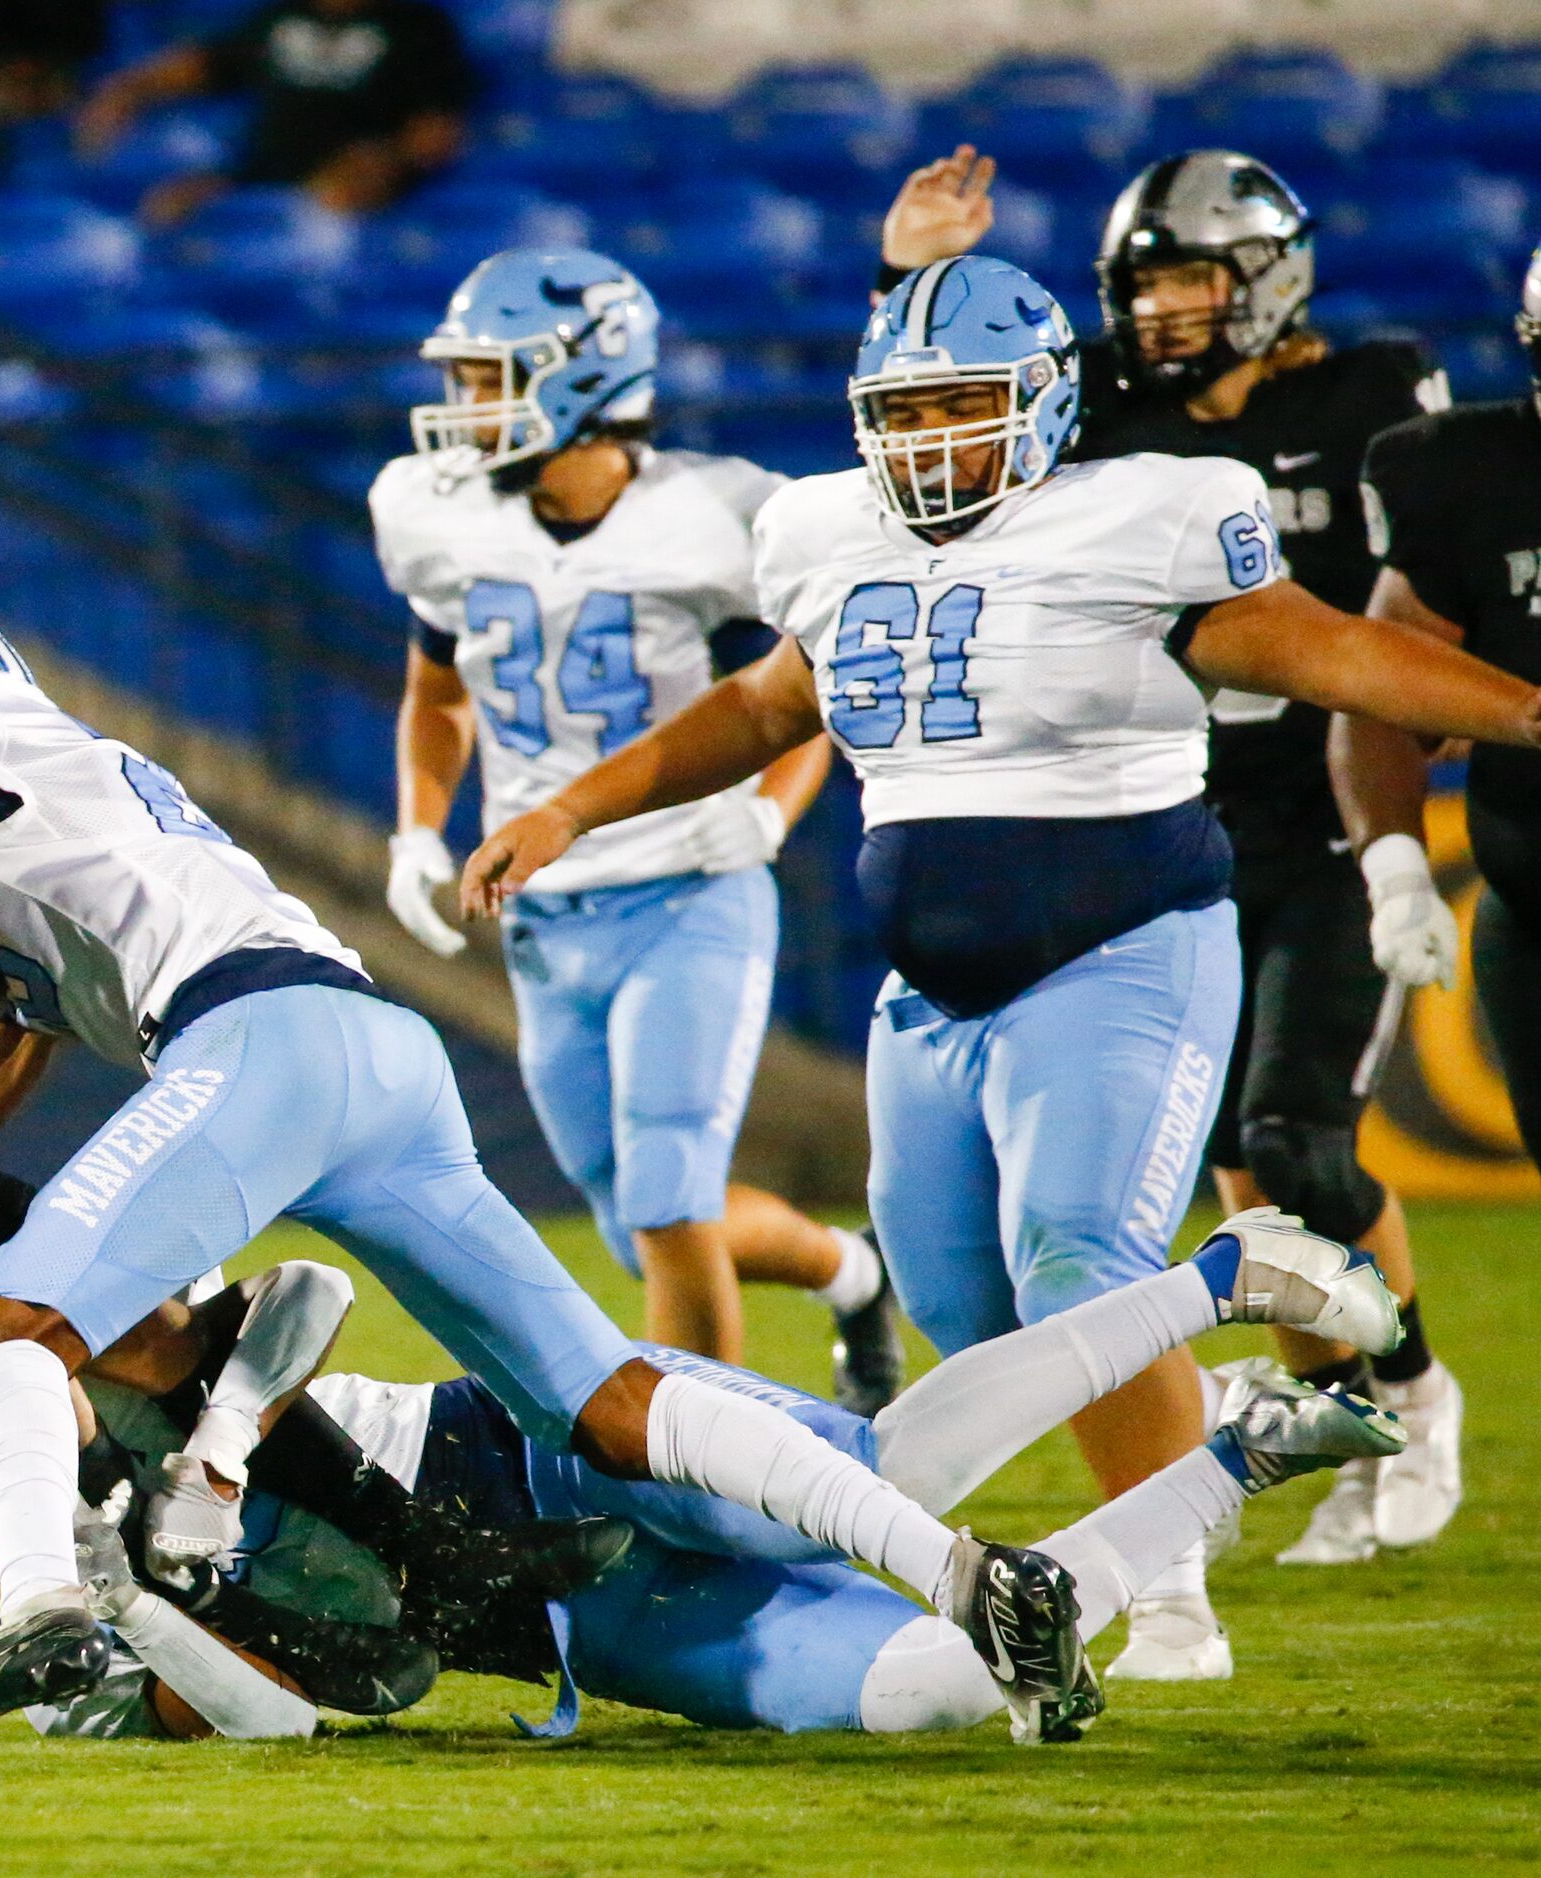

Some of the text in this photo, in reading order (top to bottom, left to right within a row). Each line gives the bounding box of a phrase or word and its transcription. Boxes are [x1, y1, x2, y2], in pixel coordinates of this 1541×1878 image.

[464, 576, 653, 759] 34
[828, 580, 986, 750] 61
[49, 1068, 225, 1229] MAVERICKS
[1126, 1040, 1215, 1244] MAVERICKS
